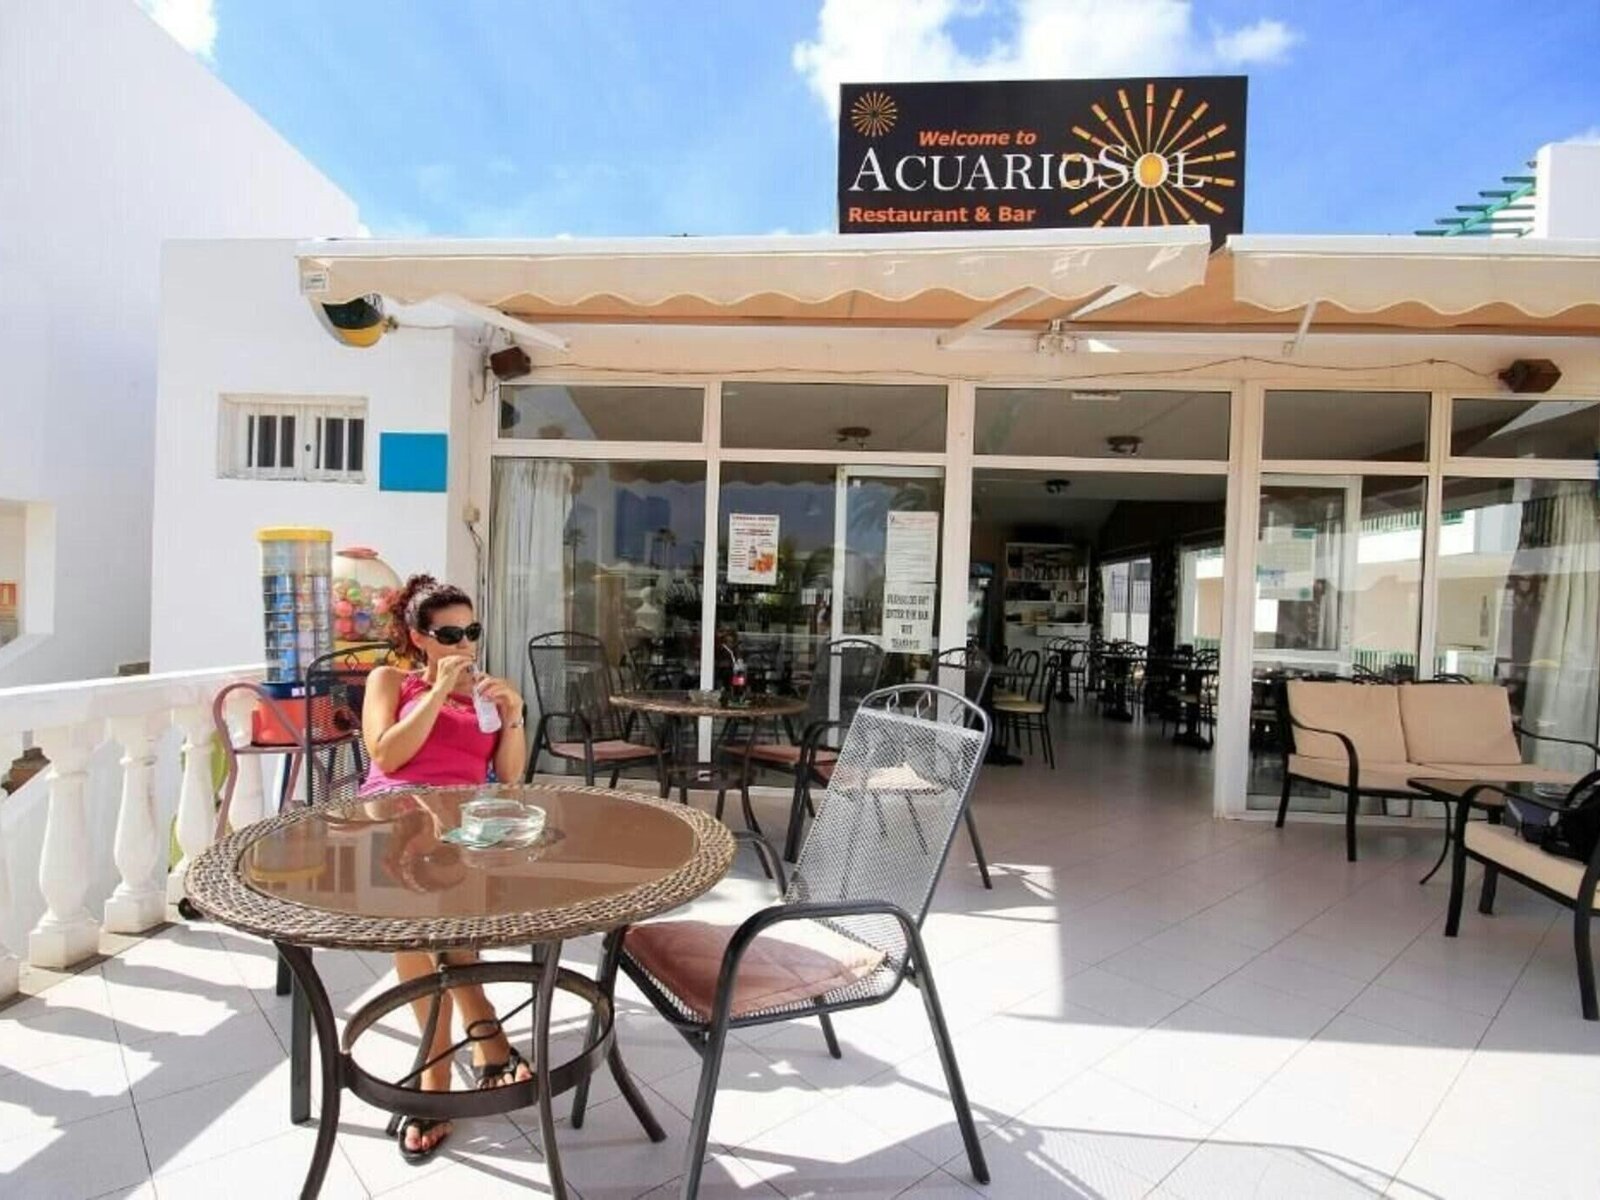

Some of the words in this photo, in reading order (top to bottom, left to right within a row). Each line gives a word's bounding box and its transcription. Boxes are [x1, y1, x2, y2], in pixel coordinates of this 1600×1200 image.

[918, 130, 1012, 147] Welcome
[1015, 130, 1037, 146] to
[847, 207, 969, 224] Restaurant
[974, 207, 992, 223] &
[998, 207, 1036, 223] Bar
